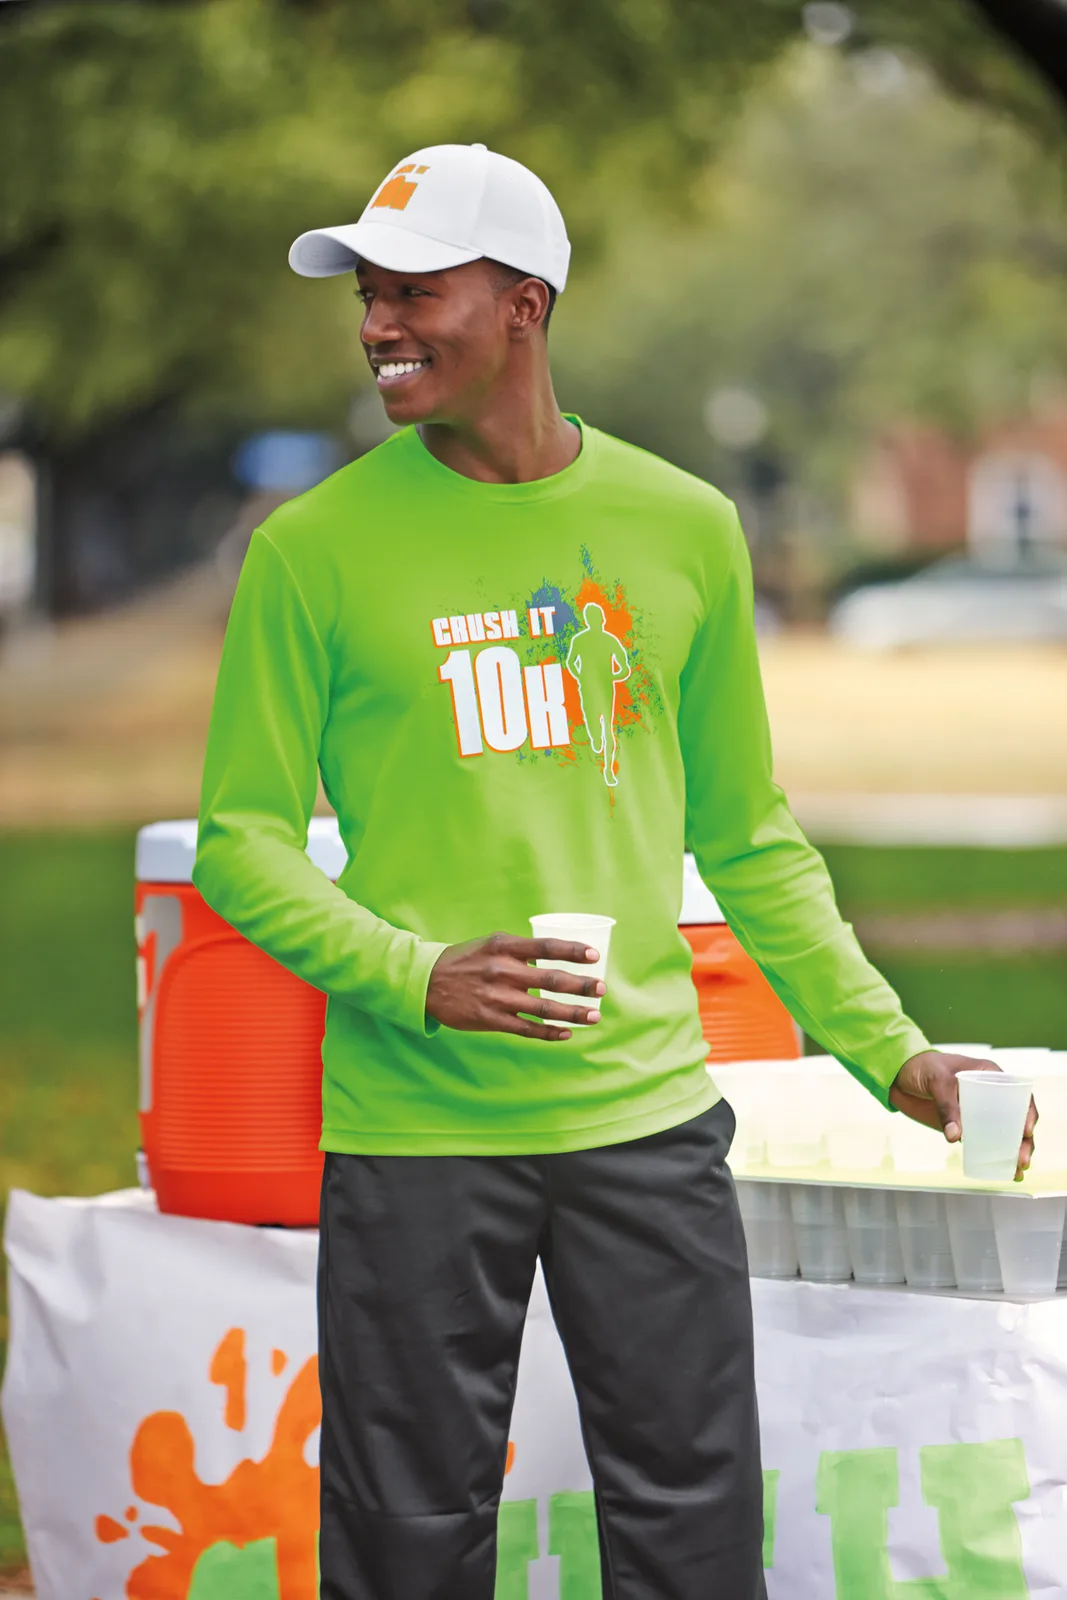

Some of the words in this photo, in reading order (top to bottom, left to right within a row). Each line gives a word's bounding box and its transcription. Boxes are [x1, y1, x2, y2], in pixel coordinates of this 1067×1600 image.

[431, 609, 520, 648] CRUSH
[527, 606, 556, 639] IT
[438, 645, 571, 759] 10K
